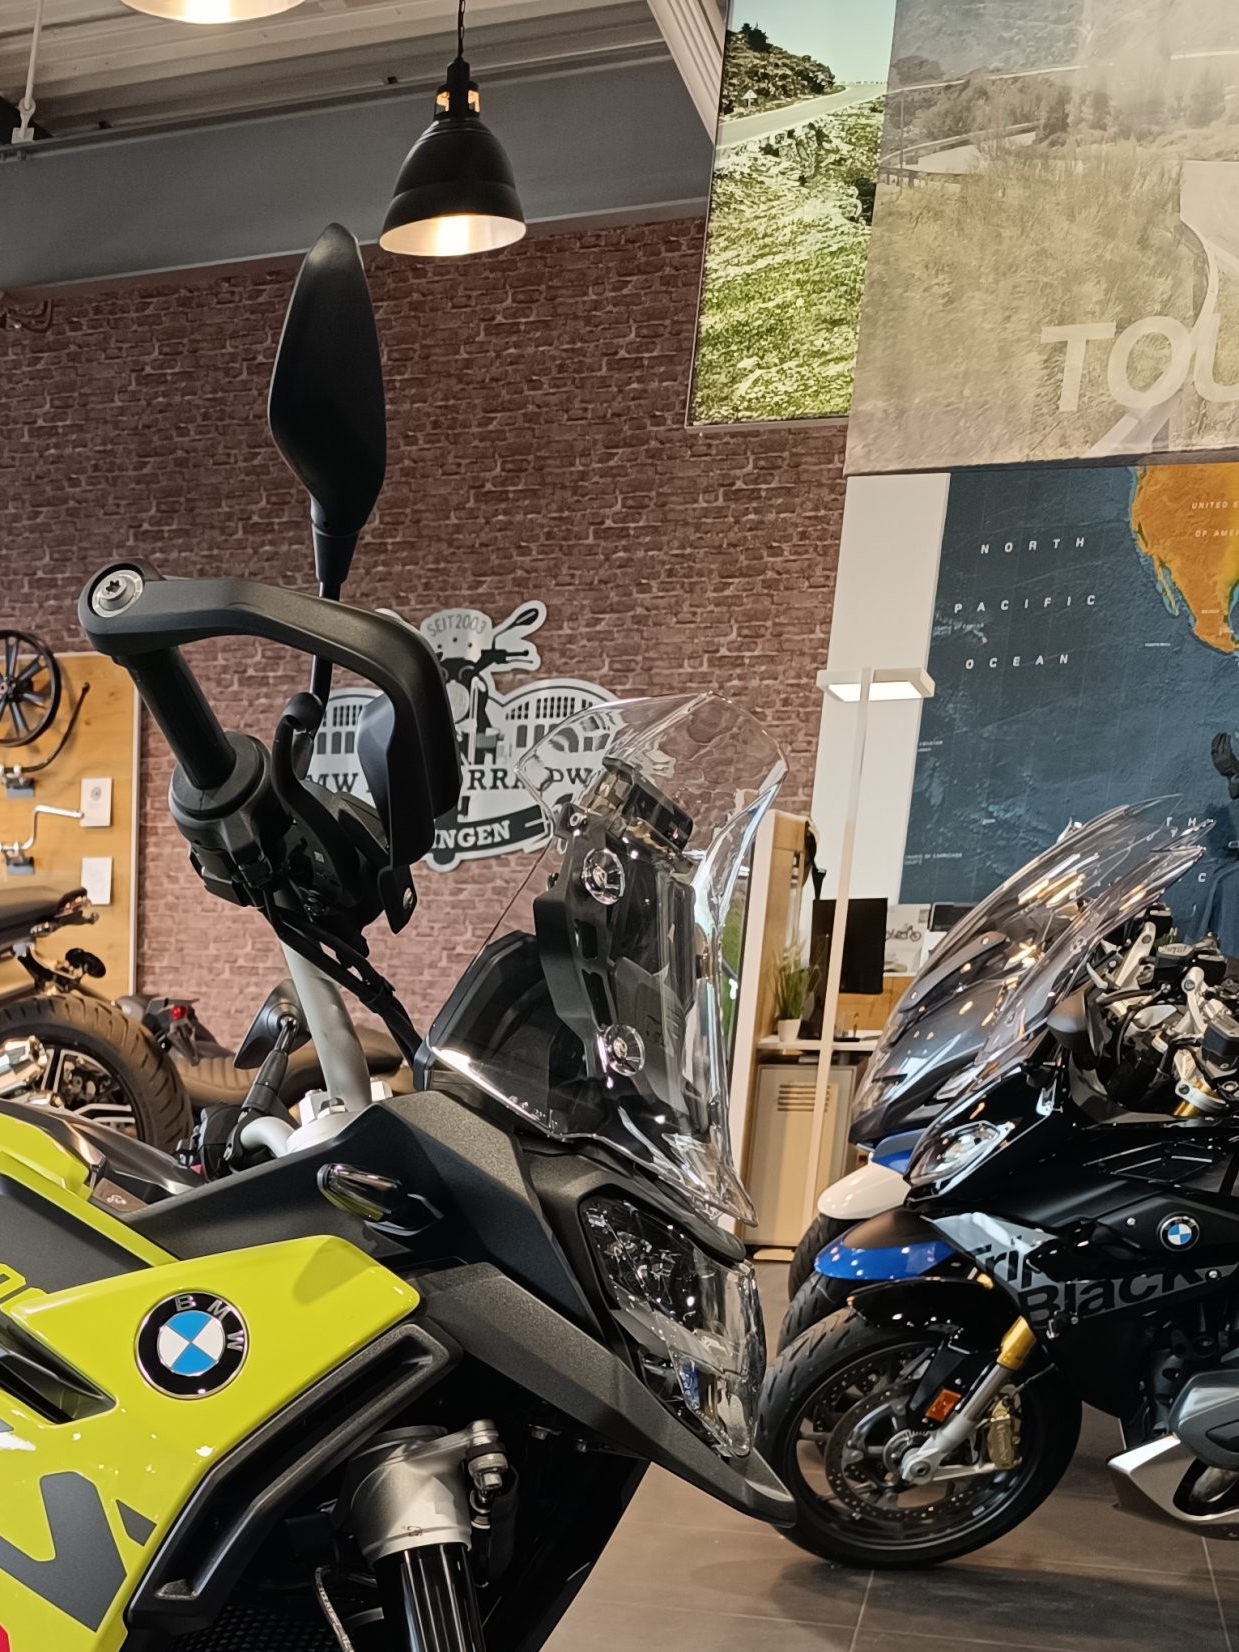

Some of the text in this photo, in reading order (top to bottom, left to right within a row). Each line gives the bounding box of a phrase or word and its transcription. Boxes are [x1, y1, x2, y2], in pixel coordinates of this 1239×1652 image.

[1191, 501, 1229, 510] UNITED
[1194, 529, 1208, 538] OF
[980, 537, 1085, 554] NORTH
[954, 594, 1096, 614] PACIFIC
[965, 654, 1069, 669] OCEAN
[306, 772, 359, 793] MW
[435, 820, 511, 850] INGEN
[174, 1294, 246, 1352] BMW
